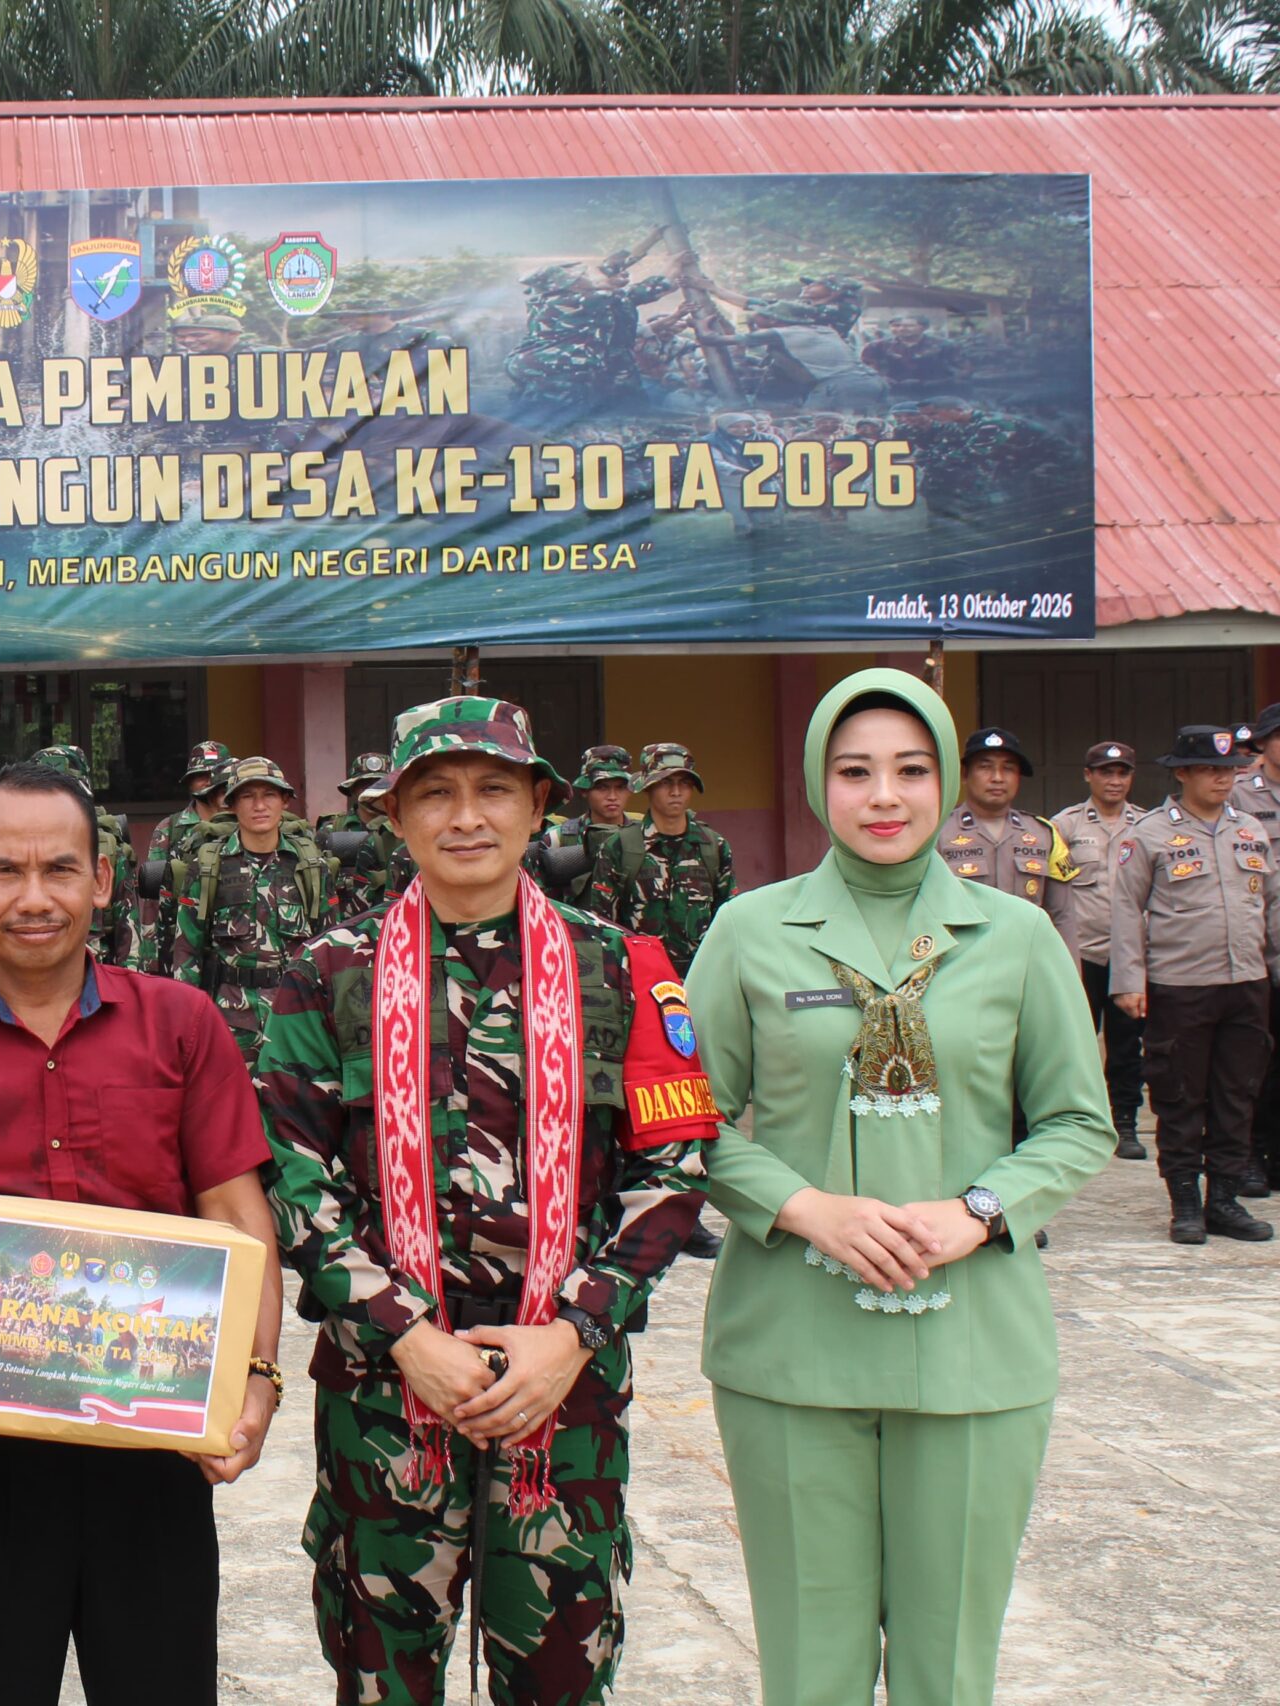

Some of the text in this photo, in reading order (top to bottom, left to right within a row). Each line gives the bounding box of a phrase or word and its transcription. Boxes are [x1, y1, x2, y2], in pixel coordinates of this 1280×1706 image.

[72, 241, 137, 255] TANJUNGPURA
[42, 347, 471, 427] PEMBUKAAN
[201, 450, 377, 522] DESA
[395, 441, 625, 517] KE-130
[645, 441, 724, 511] TA
[742, 439, 916, 508] 2026
[28, 552, 281, 588] MEMBANGUN
[292, 548, 430, 581] NEGERI
[442, 546, 529, 573] DARI
[544, 542, 654, 571] DESA"
[866, 592, 1073, 624] Landak, 13 Oktober 2026
[946, 847, 984, 860] SUYONO
[1014, 846, 1047, 857] POLRI
[1168, 847, 1200, 860] YOGI
[806, 994, 824, 1002] SASA
[825, 993, 843, 1001] DONI
[91, 1310, 210, 1344] KONTAK
[111, 1346, 132, 1361] TA
[4, 1362, 35, 1375] Satukan
[35, 1367, 66, 1381] Langkah,
[69, 1372, 113, 1386] Membangun
[114, 1378, 139, 1389] Negeri
[139, 1380, 156, 1391] dari
